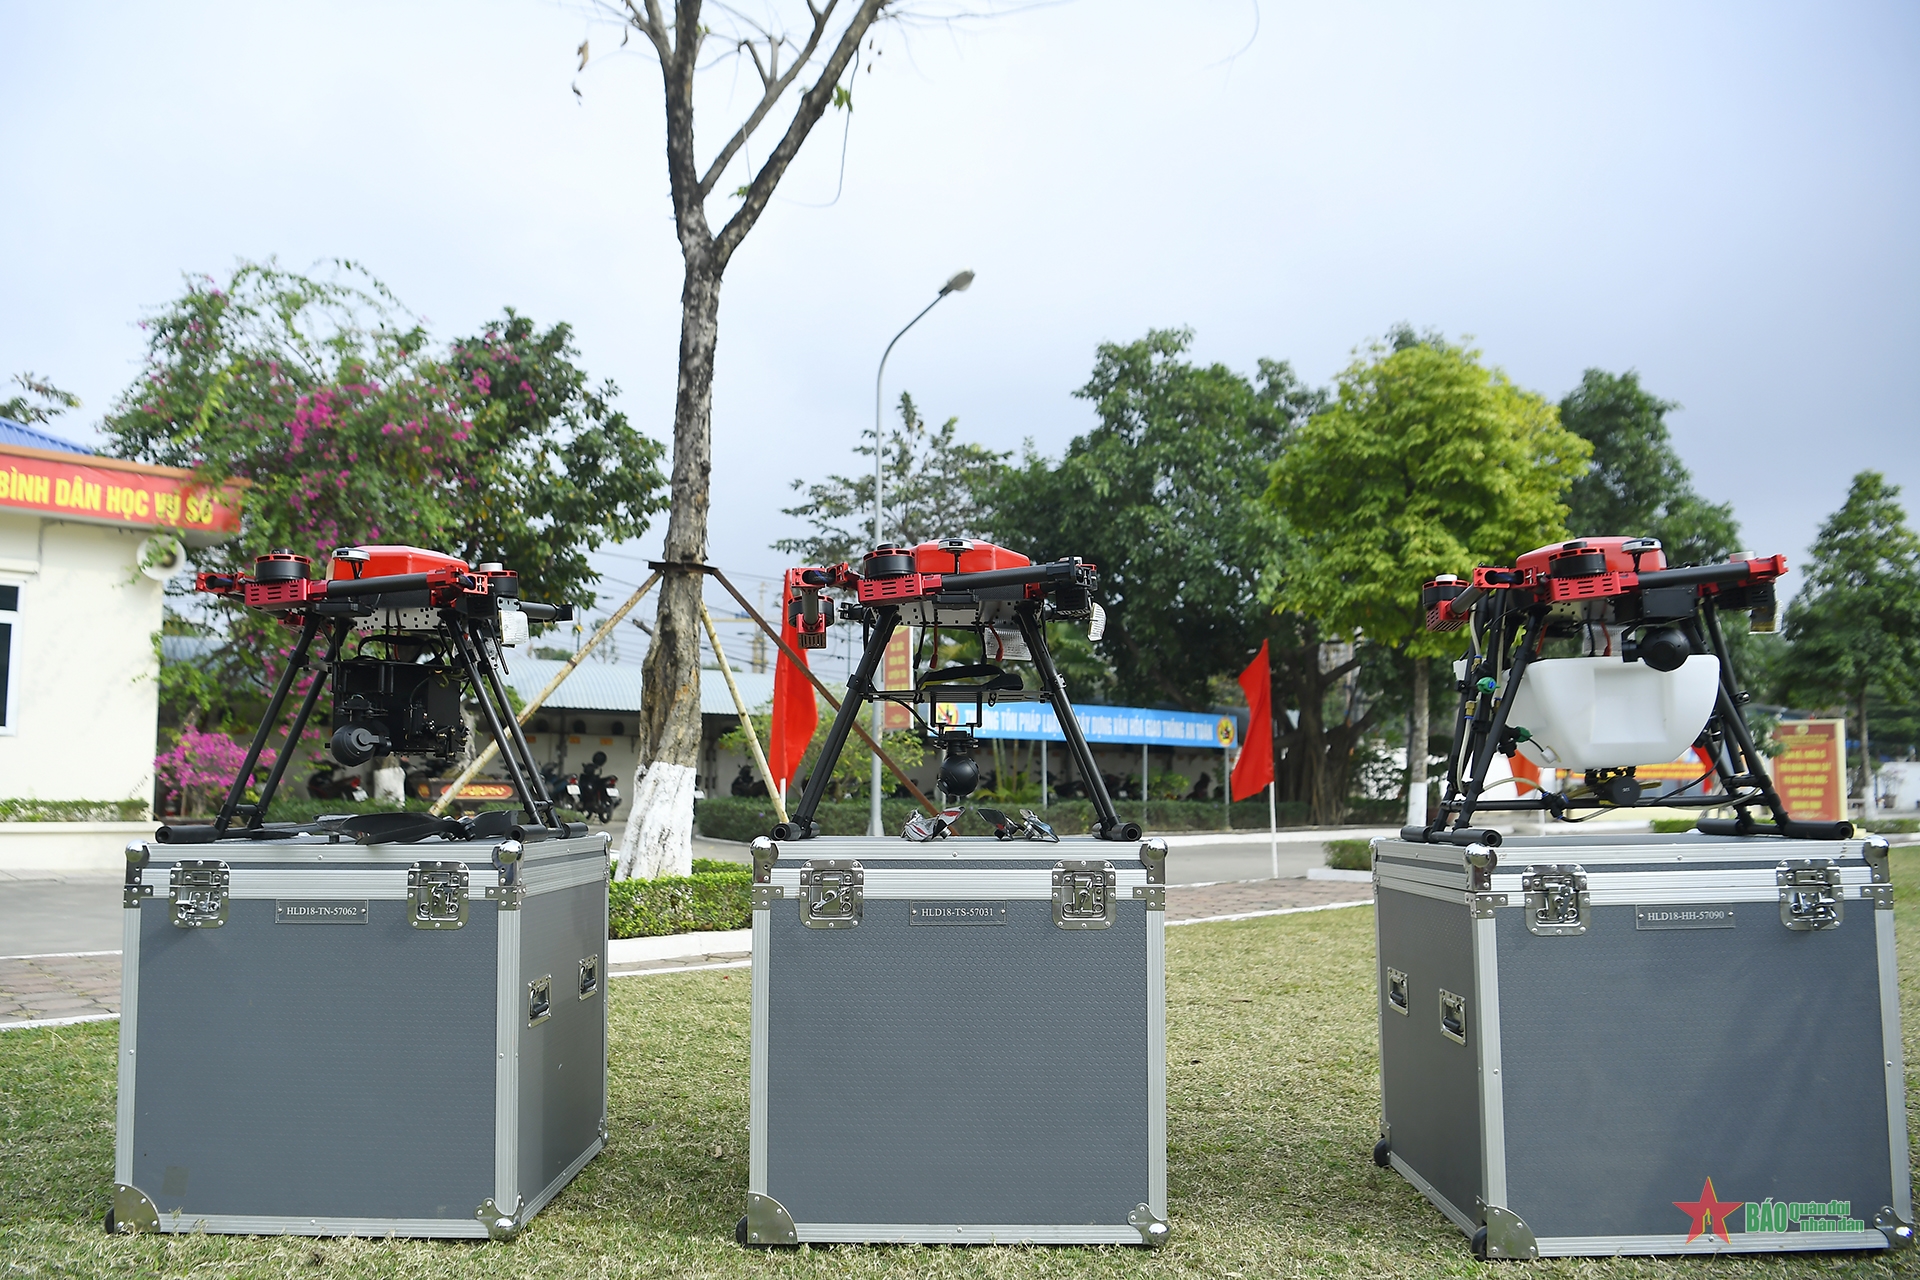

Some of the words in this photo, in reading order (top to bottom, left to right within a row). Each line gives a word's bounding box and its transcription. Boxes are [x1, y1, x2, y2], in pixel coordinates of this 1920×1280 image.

[0, 466, 50, 505] BÌNH
[55, 475, 101, 511] DÂN
[106, 484, 149, 520] HỌC
[154, 491, 182, 525] VỤ
[1019, 709, 1041, 733] PHÁP
[286, 906, 357, 916] HLD18-TN-57062
[921, 908, 993, 917] HLD18-TS-57031
[1647, 910, 1725, 921] HLD18-HH-57090
